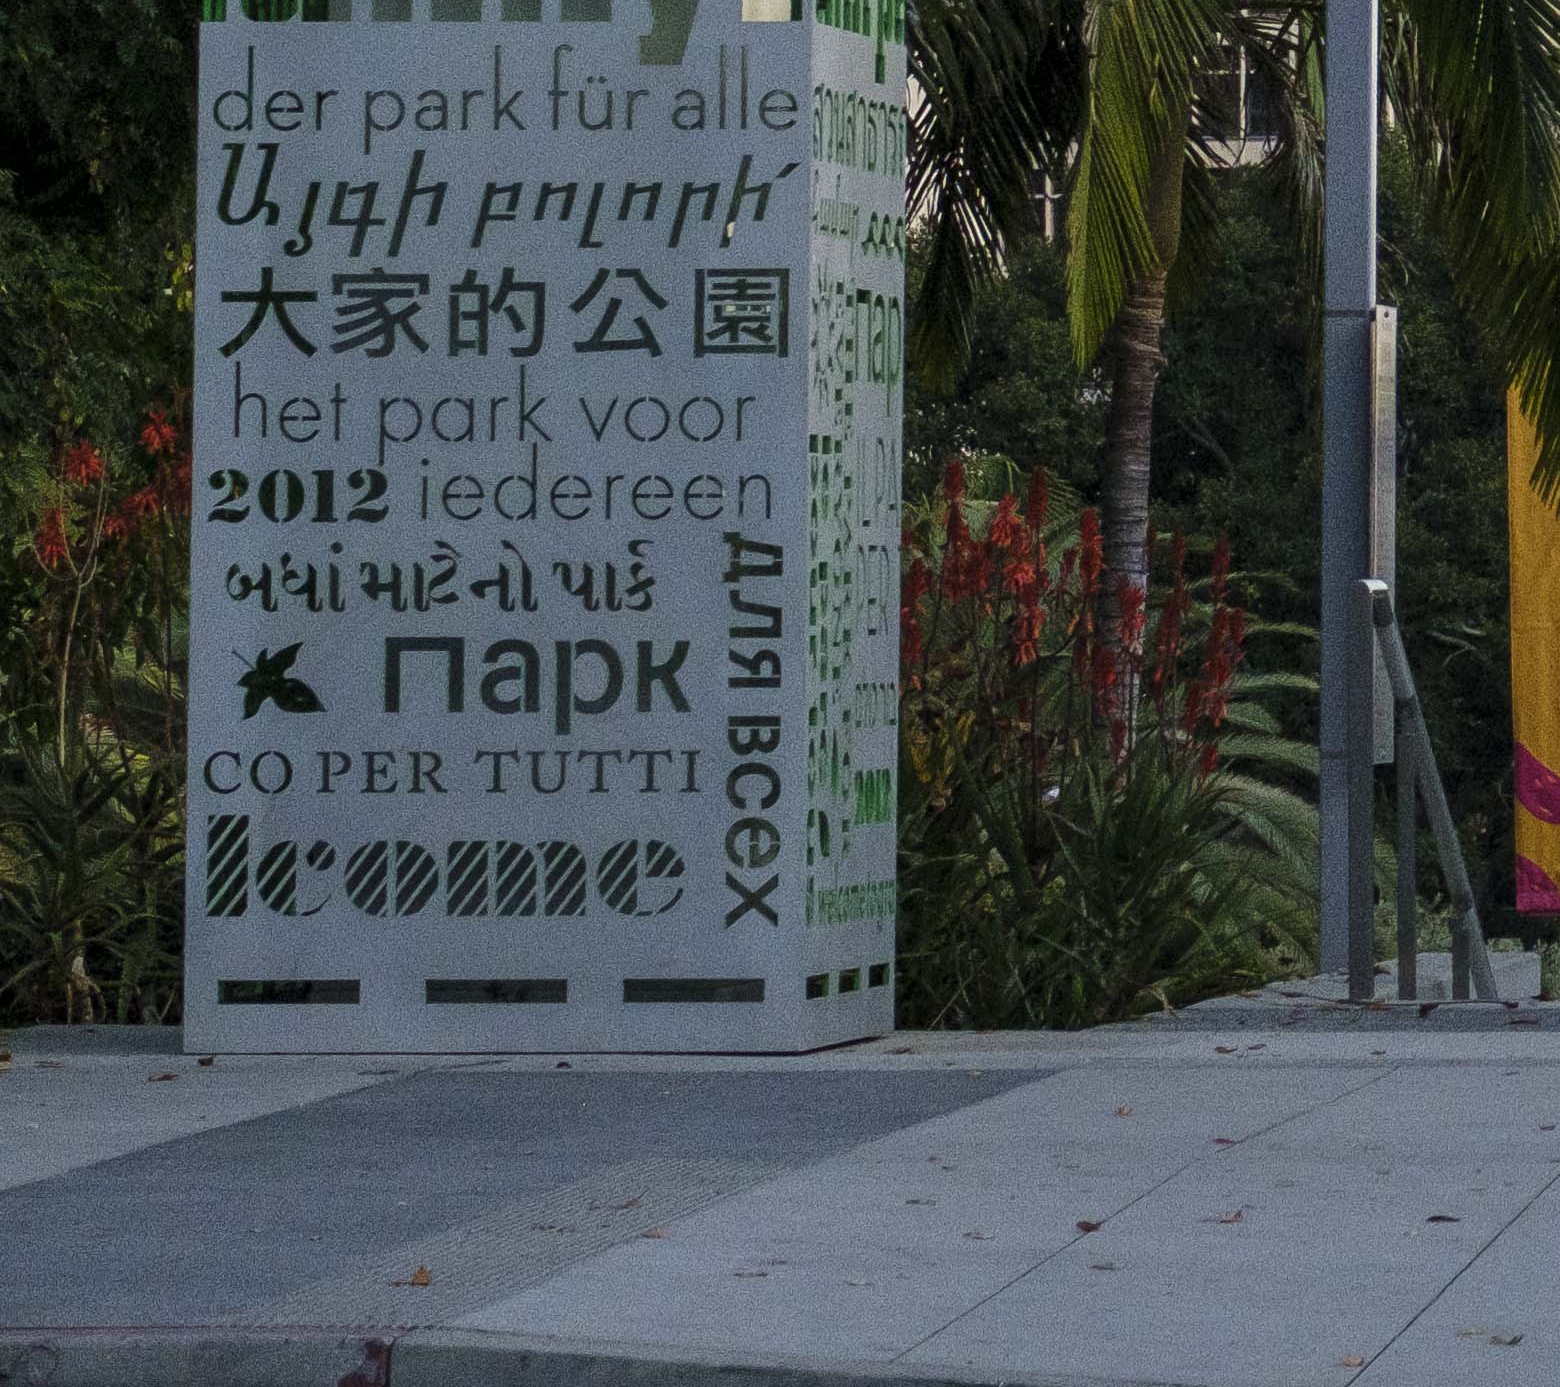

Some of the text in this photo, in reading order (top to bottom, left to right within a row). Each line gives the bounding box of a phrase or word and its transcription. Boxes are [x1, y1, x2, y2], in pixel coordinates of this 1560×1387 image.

[213, 44, 799, 155] der park für alle
[220, 267, 789, 357] 大家的公園
[234, 361, 755, 466] het park voor
[209, 470, 388, 523] 2012
[419, 444, 773, 521] iedereen
[203, 750, 699, 795] CO PER TUTTI
